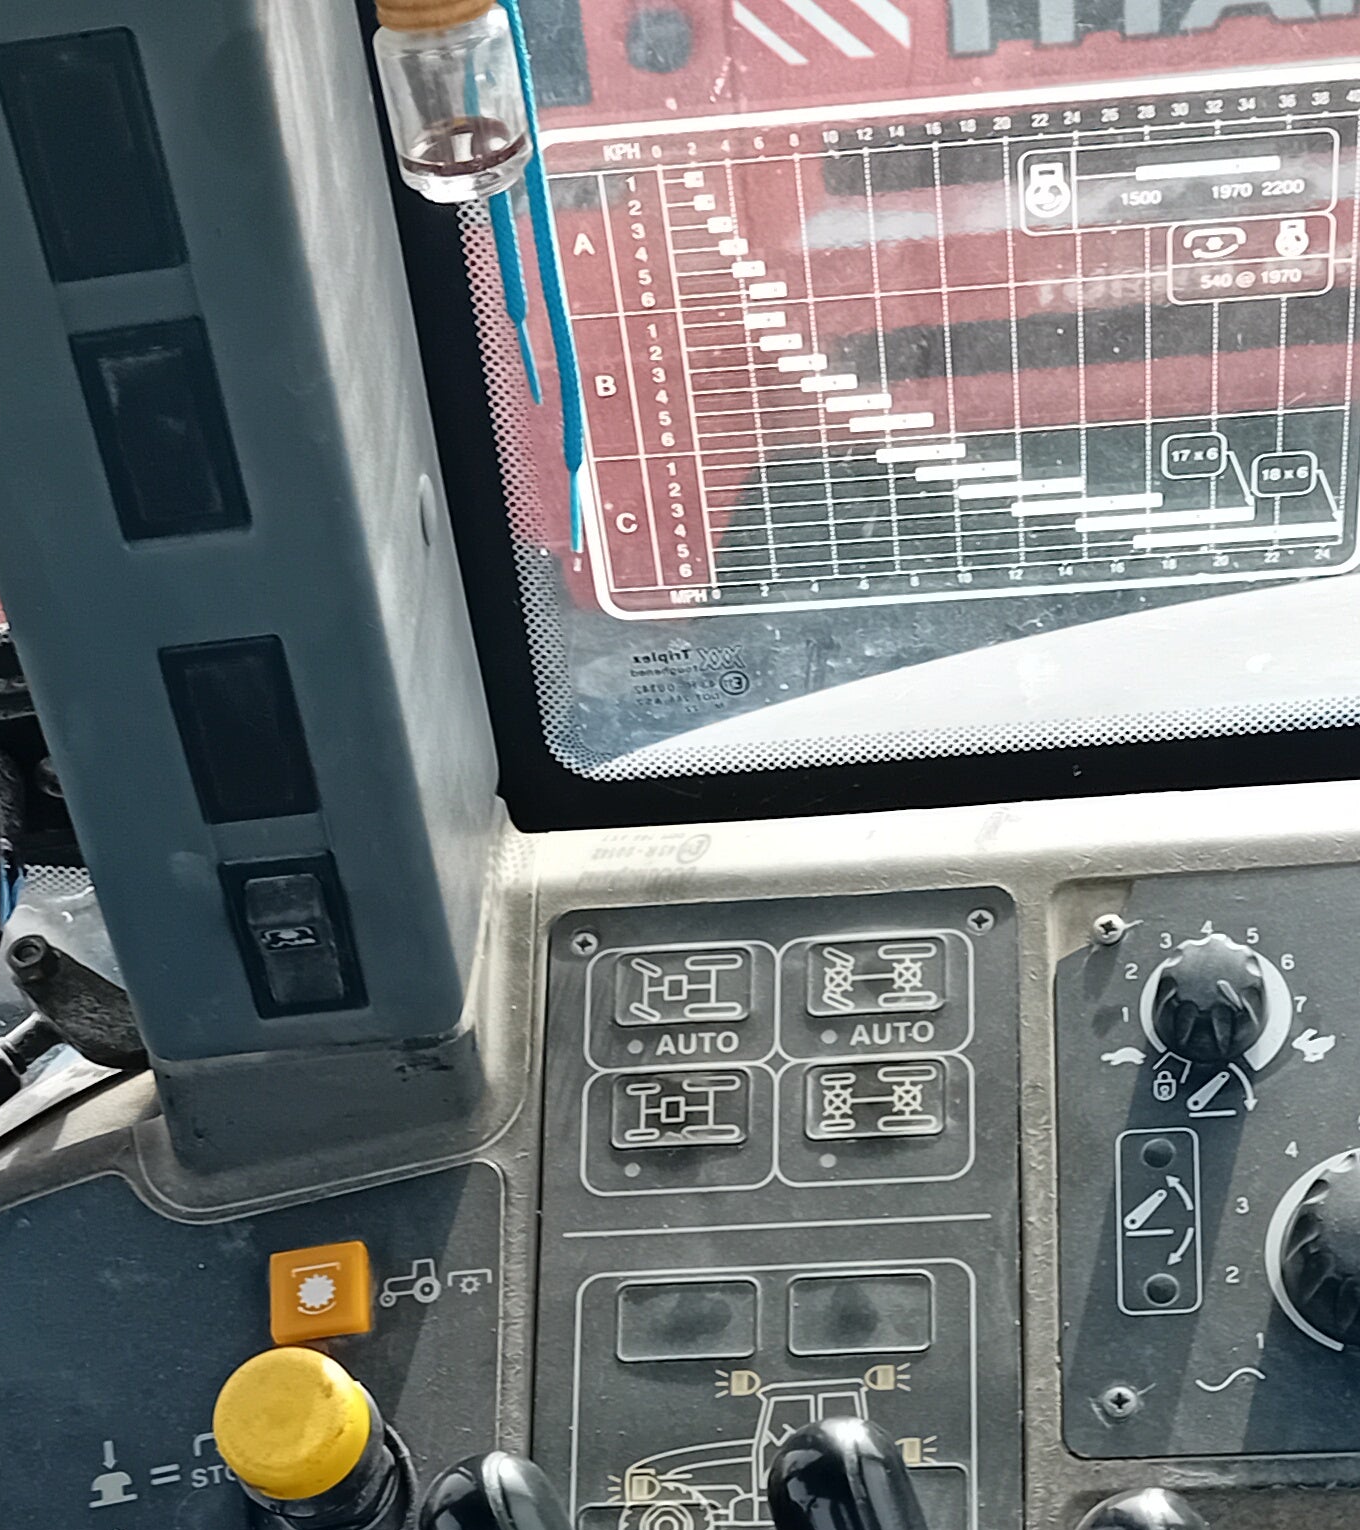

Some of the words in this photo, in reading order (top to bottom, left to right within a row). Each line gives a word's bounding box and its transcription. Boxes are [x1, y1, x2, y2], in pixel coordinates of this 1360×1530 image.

[603, 143, 640, 161] KPH
[651, 145, 662, 158] 0
[688, 142, 697, 156] 2
[720, 139, 731, 153] 4
[754, 136, 764, 149] 6
[789, 134, 799, 147] 8
[822, 130, 839, 144] 10
[856, 128, 873, 141] 12
[889, 125, 904, 138] 14
[925, 122, 942, 136] 16
[959, 119, 976, 132] 18
[992, 116, 1011, 130] 20
[1031, 113, 1049, 127] 22
[1063, 111, 1081, 125] 24
[1100, 108, 1119, 123] 26
[1137, 105, 1156, 119] 28
[1170, 102, 1189, 116] 30
[1205, 99, 1224, 114] 32
[1237, 97, 1256, 112] 34
[1278, 94, 1297, 108] 36
[1311, 91, 1330, 106] 38
[625, 175, 636, 192] 1
[1121, 188, 1162, 207] 1500
[1211, 181, 1253, 199] 1970
[1261, 178, 1305, 196] 2200
[627, 200, 642, 216] 2
[630, 223, 646, 239] 3
[573, 233, 595, 256] A
[634, 246, 648, 262] 4
[638, 269, 652, 285] 5
[1200, 272, 1232, 290] 540
[1235, 270, 1256, 288] @
[1261, 267, 1302, 285] 1970
[641, 291, 656, 308] 6
[646, 323, 657, 338] 1
[649, 345, 663, 361] 2
[651, 367, 666, 383] 3
[594, 375, 617, 397] B
[655, 389, 669, 404] 4
[658, 411, 672, 426] 5
[661, 432, 675, 447] 6
[1171, 448, 1192, 463] 17
[1194, 451, 1204, 460] x
[1206, 446, 1218, 460] 6
[666, 462, 676, 476] 1
[1261, 467, 1282, 481] 18
[1283, 469, 1294, 479] x
[1296, 466, 1309, 479] 6
[668, 483, 681, 497] 2
[670, 503, 684, 518] 3
[615, 512, 638, 533] C
[674, 524, 687, 538] 4
[677, 544, 690, 558] 5
[669, 588, 708, 604] MPH
[711, 589, 721, 600] 0
[760, 585, 769, 597] 2
[810, 581, 820, 593] 4
[857, 578, 869, 590] 6
[909, 575, 920, 587] 8
[958, 570, 972, 583] 10
[1008, 568, 1023, 580] 12
[1058, 565, 1073, 577] 14
[1110, 562, 1125, 574] 16
[1162, 558, 1177, 570] 18
[1213, 554, 1229, 566] 20
[1264, 551, 1280, 563] 22
[1314, 548, 1330, 560] 24
[679, 563, 693, 577] 6
[1200, 920, 1214, 937] 4
[1246, 928, 1260, 945] 5
[1159, 932, 1173, 949] 3
[1281, 954, 1294, 971] 6
[1125, 963, 1138, 981] 2
[1294, 996, 1307, 1013] 7
[1122, 1007, 1129, 1023] 1
[849, 1021, 935, 1045] AUTO
[655, 1032, 740, 1056] AUTO
[1284, 1141, 1299, 1158] 4
[1235, 1197, 1250, 1214] 3
[1225, 1266, 1240, 1283] 2
[1256, 1332, 1265, 1349] 1
